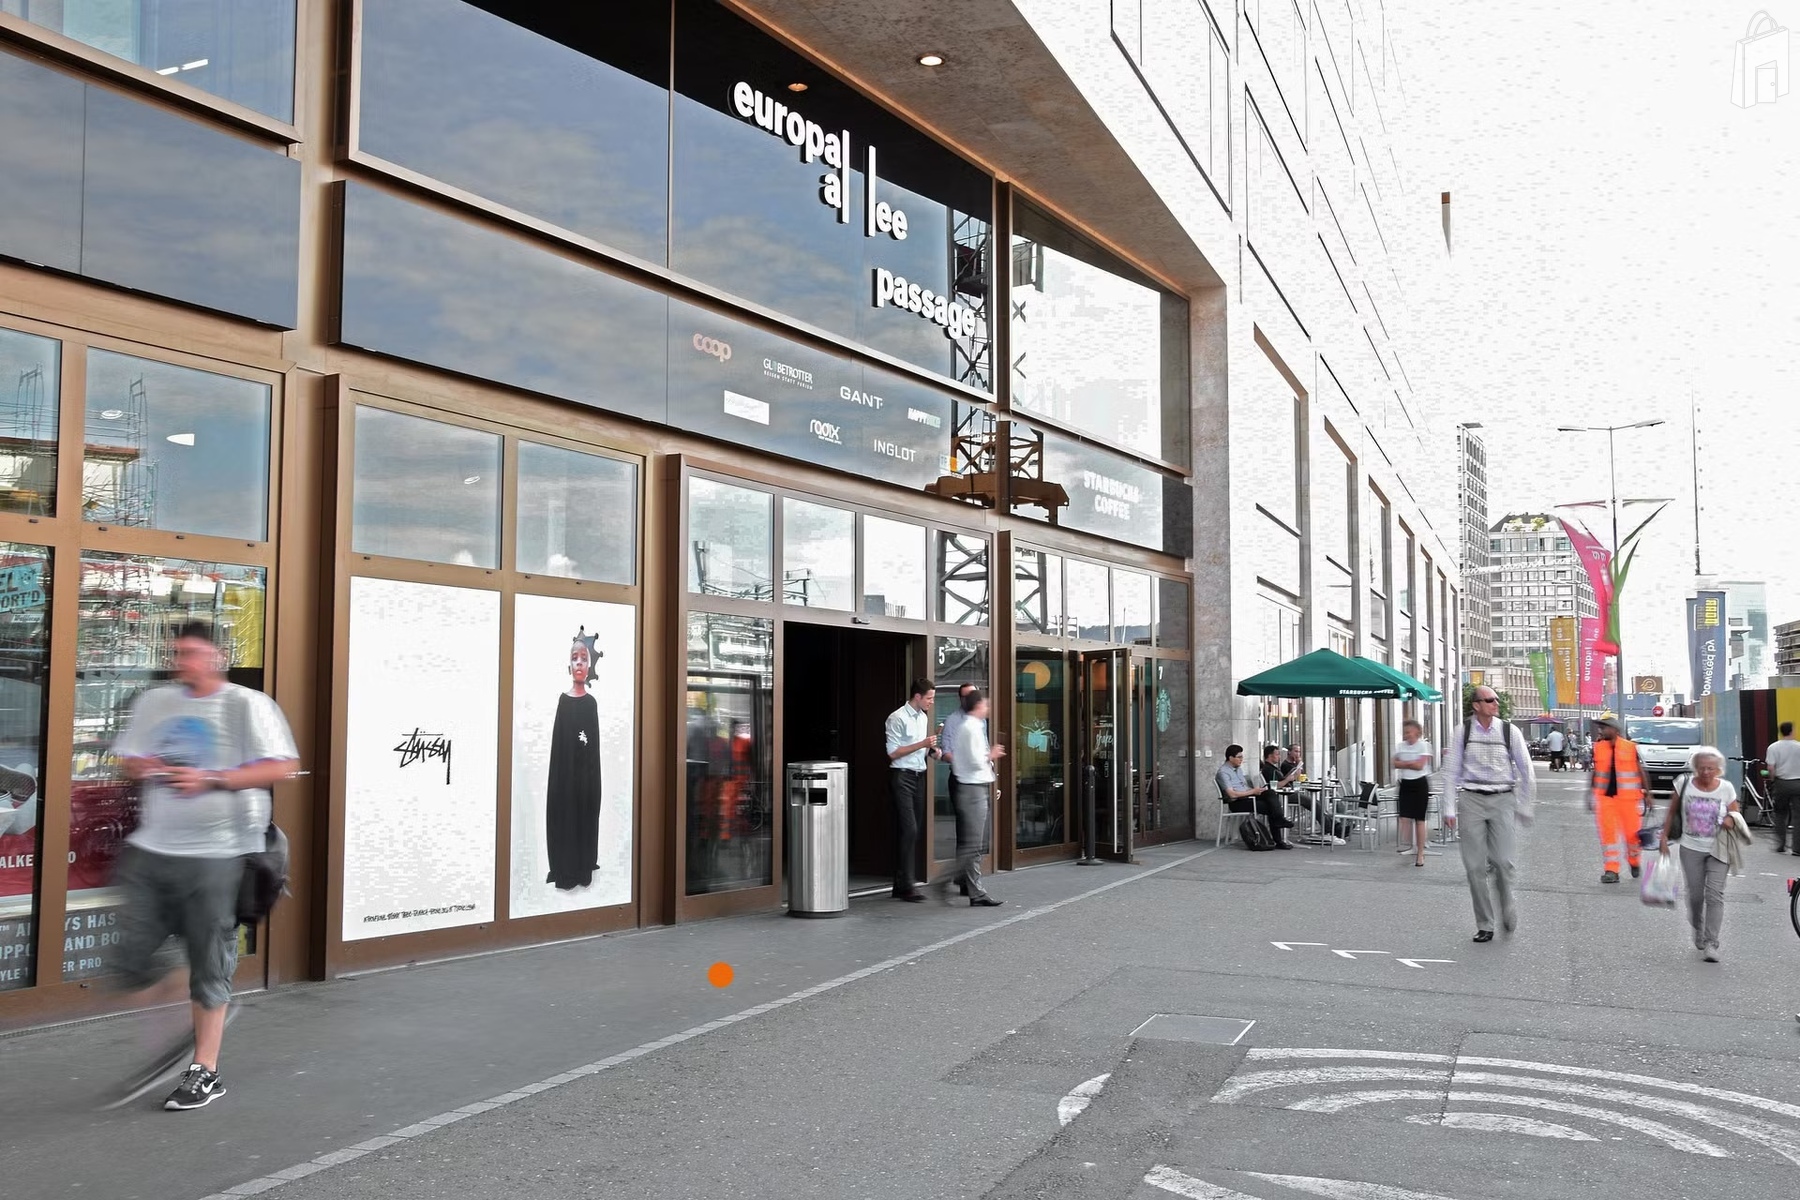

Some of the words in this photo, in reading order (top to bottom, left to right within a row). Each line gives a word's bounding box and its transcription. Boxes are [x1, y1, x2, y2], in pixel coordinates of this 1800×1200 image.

[876, 267, 976, 340] passage
[693, 333, 732, 363] coop
[840, 386, 883, 409] GANT
[873, 439, 917, 462] INGLOT
[938, 646, 946, 665] 5
[1158, 665, 1164, 680] 7
[87, 912, 117, 929] HAS
[63, 935, 95, 952] AND
